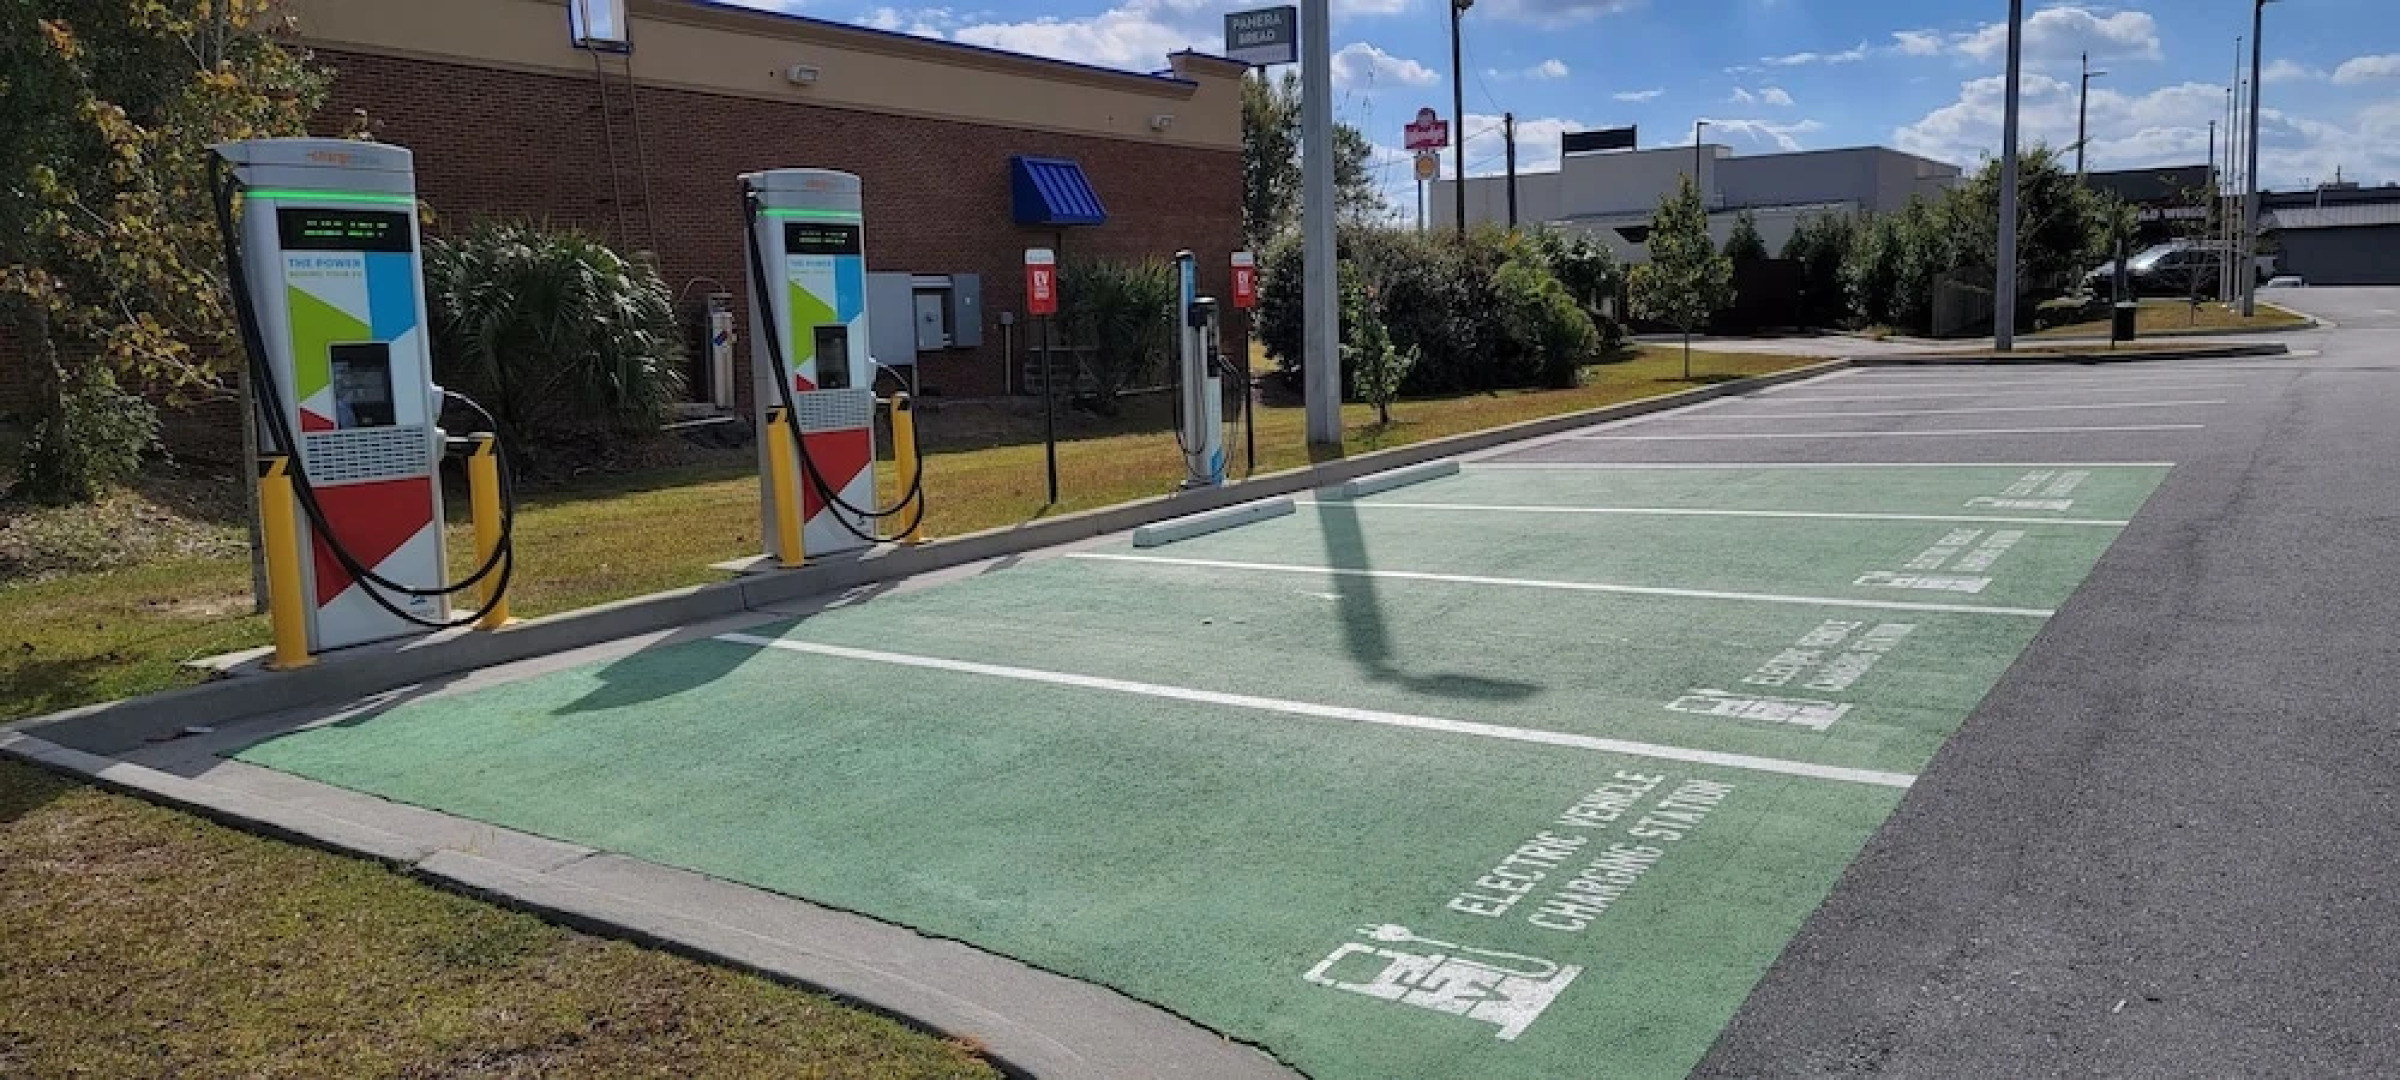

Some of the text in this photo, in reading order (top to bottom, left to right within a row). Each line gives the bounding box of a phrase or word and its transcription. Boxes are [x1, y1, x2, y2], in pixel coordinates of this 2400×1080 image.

[1447, 770, 1665, 917] ELECTRIC VEHICLE
[1528, 779, 1736, 932] CHARGING STATION
